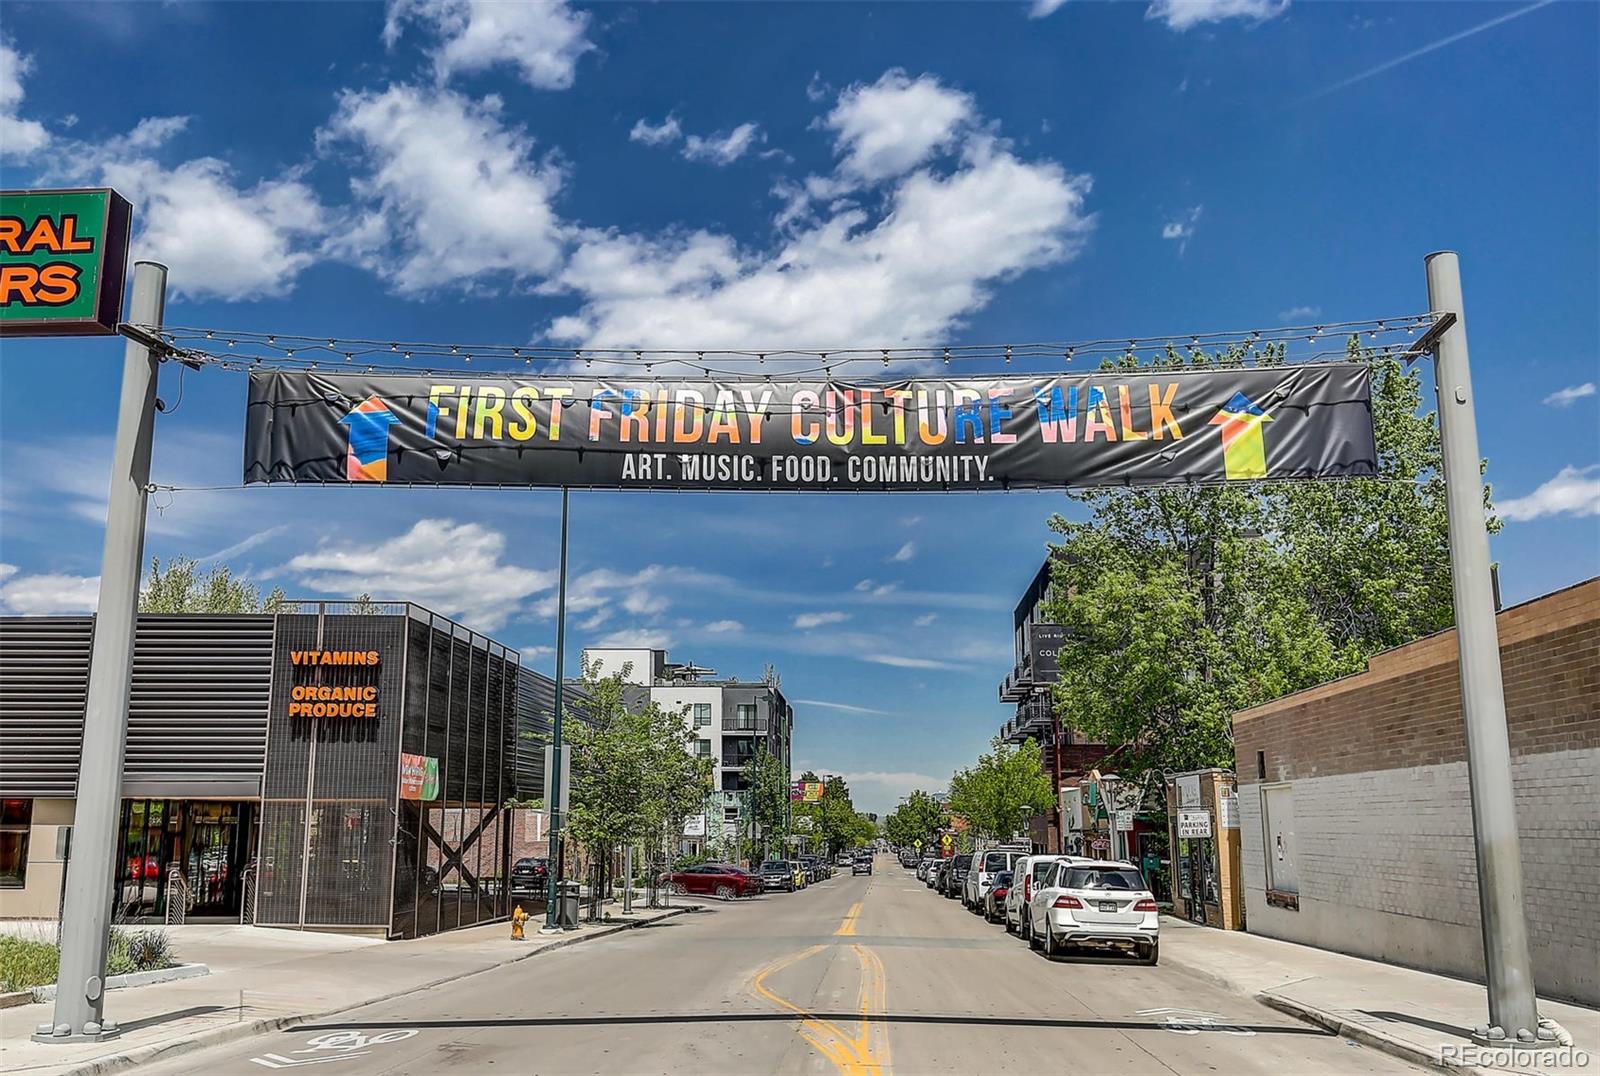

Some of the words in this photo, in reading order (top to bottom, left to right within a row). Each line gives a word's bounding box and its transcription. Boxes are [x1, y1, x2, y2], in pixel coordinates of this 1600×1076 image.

[425, 384, 574, 442] FIRST
[588, 388, 774, 444] FRIDAY
[790, 387, 1018, 446] CULTURE
[1033, 382, 1184, 444] WALK
[621, 453, 671, 480] ART.
[681, 454, 762, 482] MUSIC.
[771, 455, 839, 483] FOOD.
[848, 455, 994, 483] COMMUNITY.
[290, 650, 379, 666] VITAMINS
[291, 686, 378, 701] ORGANIC
[288, 702, 377, 718] PRODUCE
